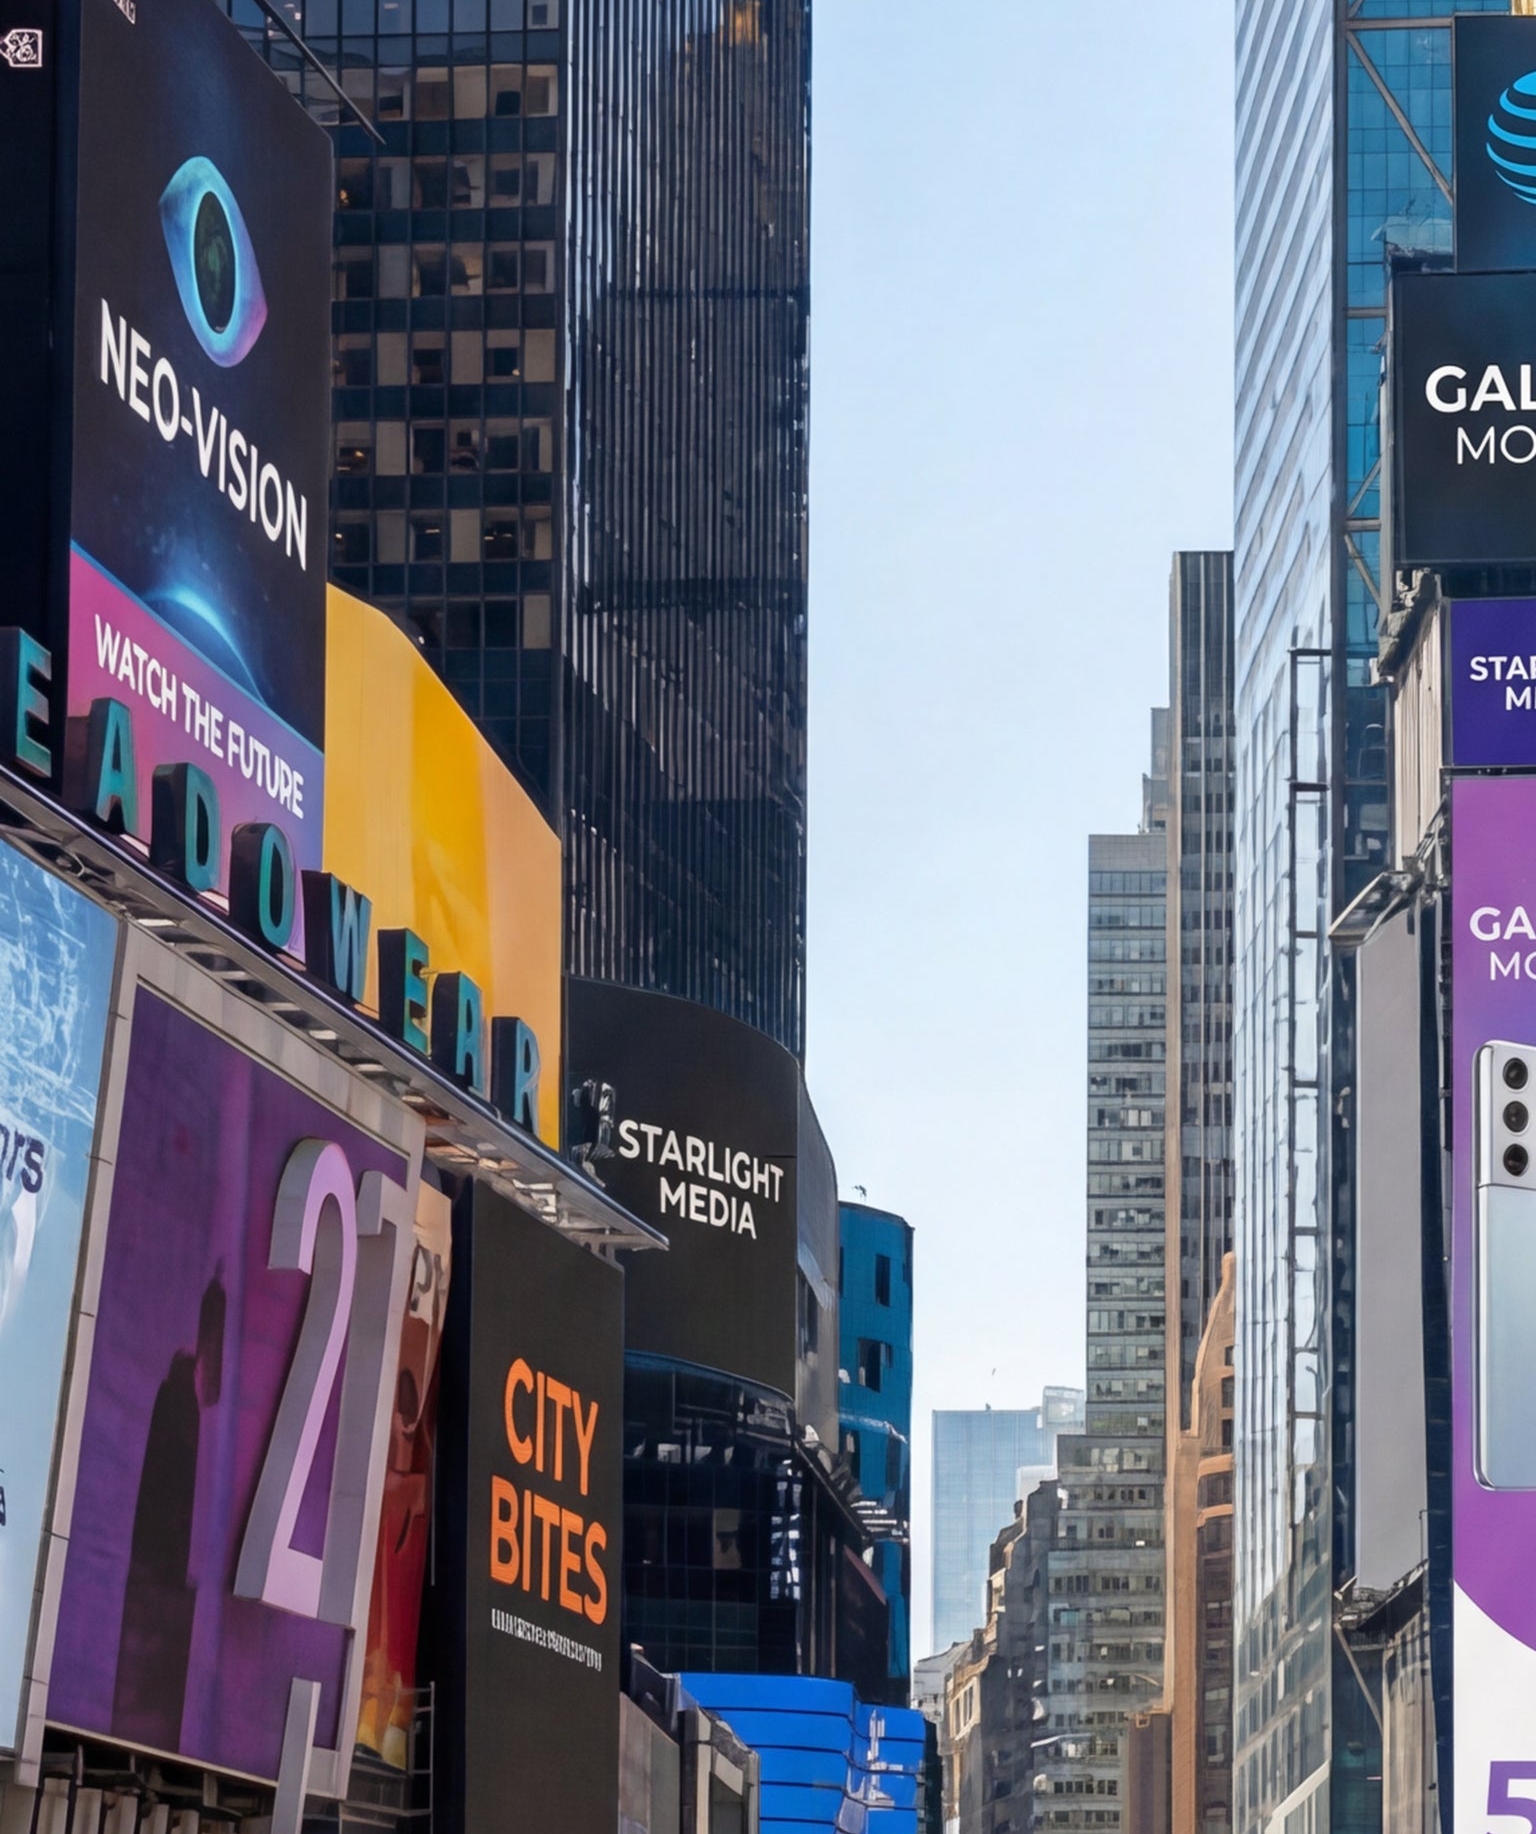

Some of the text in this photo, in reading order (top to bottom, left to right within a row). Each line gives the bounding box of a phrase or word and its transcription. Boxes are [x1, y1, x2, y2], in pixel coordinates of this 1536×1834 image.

[100, 298, 308, 571] NEO-VISION
[94, 614, 304, 819] WATCH THE FUTURE
[618, 1119, 784, 1203] STARLIGHT
[660, 1176, 757, 1240] MEDIA
[504, 1358, 599, 1496] CITY
[490, 1475, 608, 1626] BITES
